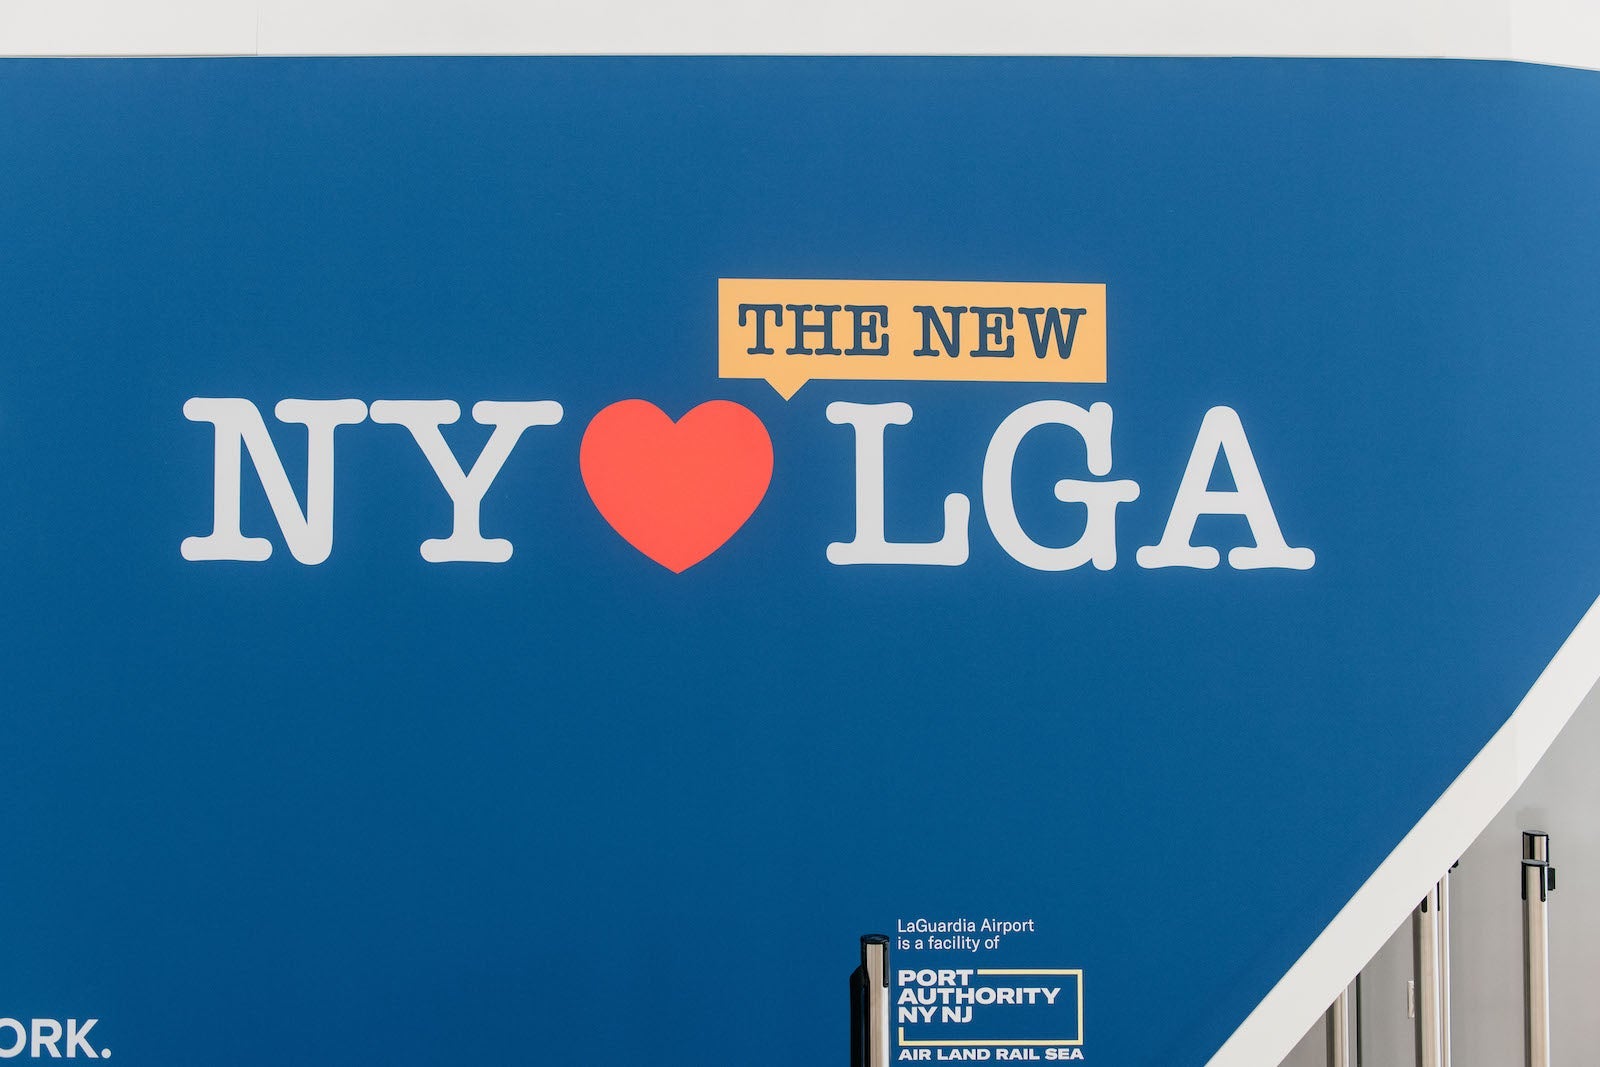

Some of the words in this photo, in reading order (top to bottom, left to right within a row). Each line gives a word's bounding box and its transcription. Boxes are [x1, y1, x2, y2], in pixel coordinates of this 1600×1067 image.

[739, 303, 890, 357] THE
[913, 305, 1088, 360] NEW
[181, 397, 564, 566] NY
[825, 400, 1316, 572] LGA
[897, 918, 976, 933] LaGuardia
[980, 918, 1035, 936] Airport
[897, 936, 911, 950] is
[914, 939, 924, 950] a
[927, 936, 981, 953] facility
[984, 936, 1000, 950] of
[898, 969, 974, 986] PORT
[897, 987, 1061, 1005] AUTHORITY
[898, 1006, 938, 1023] NY
[941, 1006, 973, 1023] NJ
[898, 1048, 932, 1061] AIR
[937, 1048, 991, 1061] LAND
[995, 1048, 1041, 1061] RAIL
[1044, 1048, 1085, 1061] SEA
